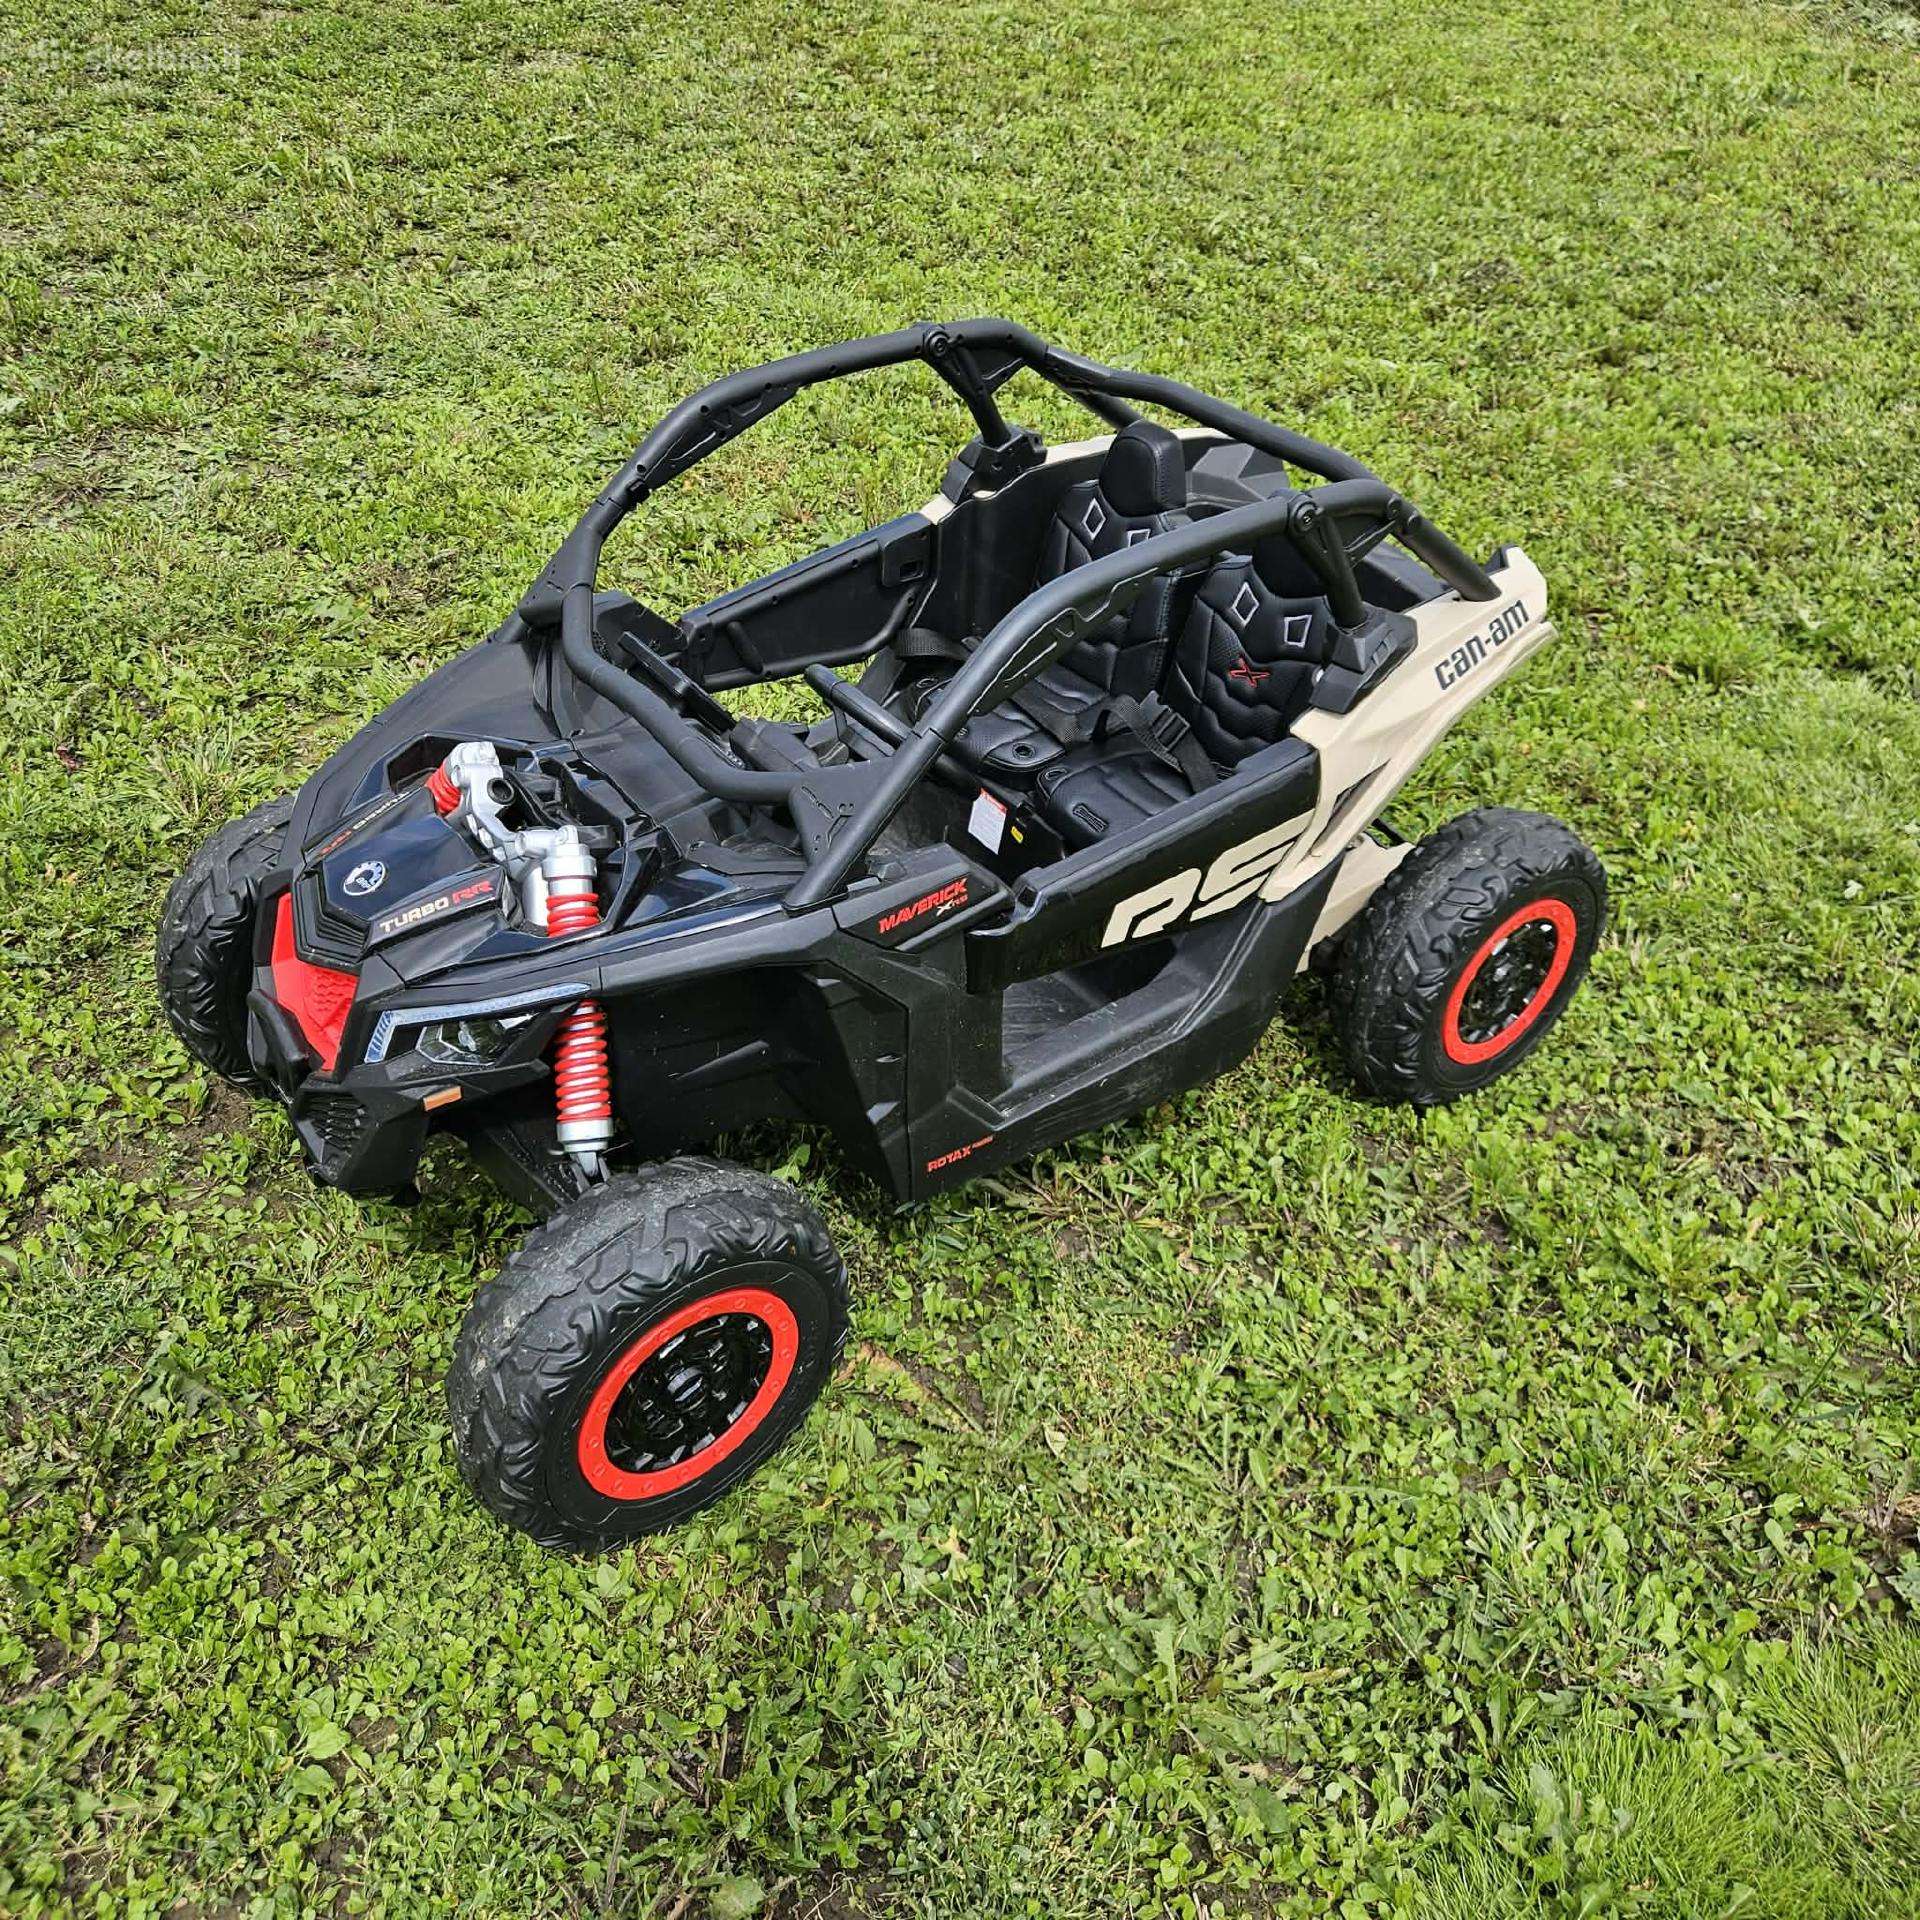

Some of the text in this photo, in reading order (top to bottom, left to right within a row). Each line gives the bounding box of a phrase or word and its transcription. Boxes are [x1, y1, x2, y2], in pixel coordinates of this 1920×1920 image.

[380, 896, 450, 933] TURBO
[878, 877, 968, 935] MAVERICK
[927, 1144, 972, 1173] ROTAX
